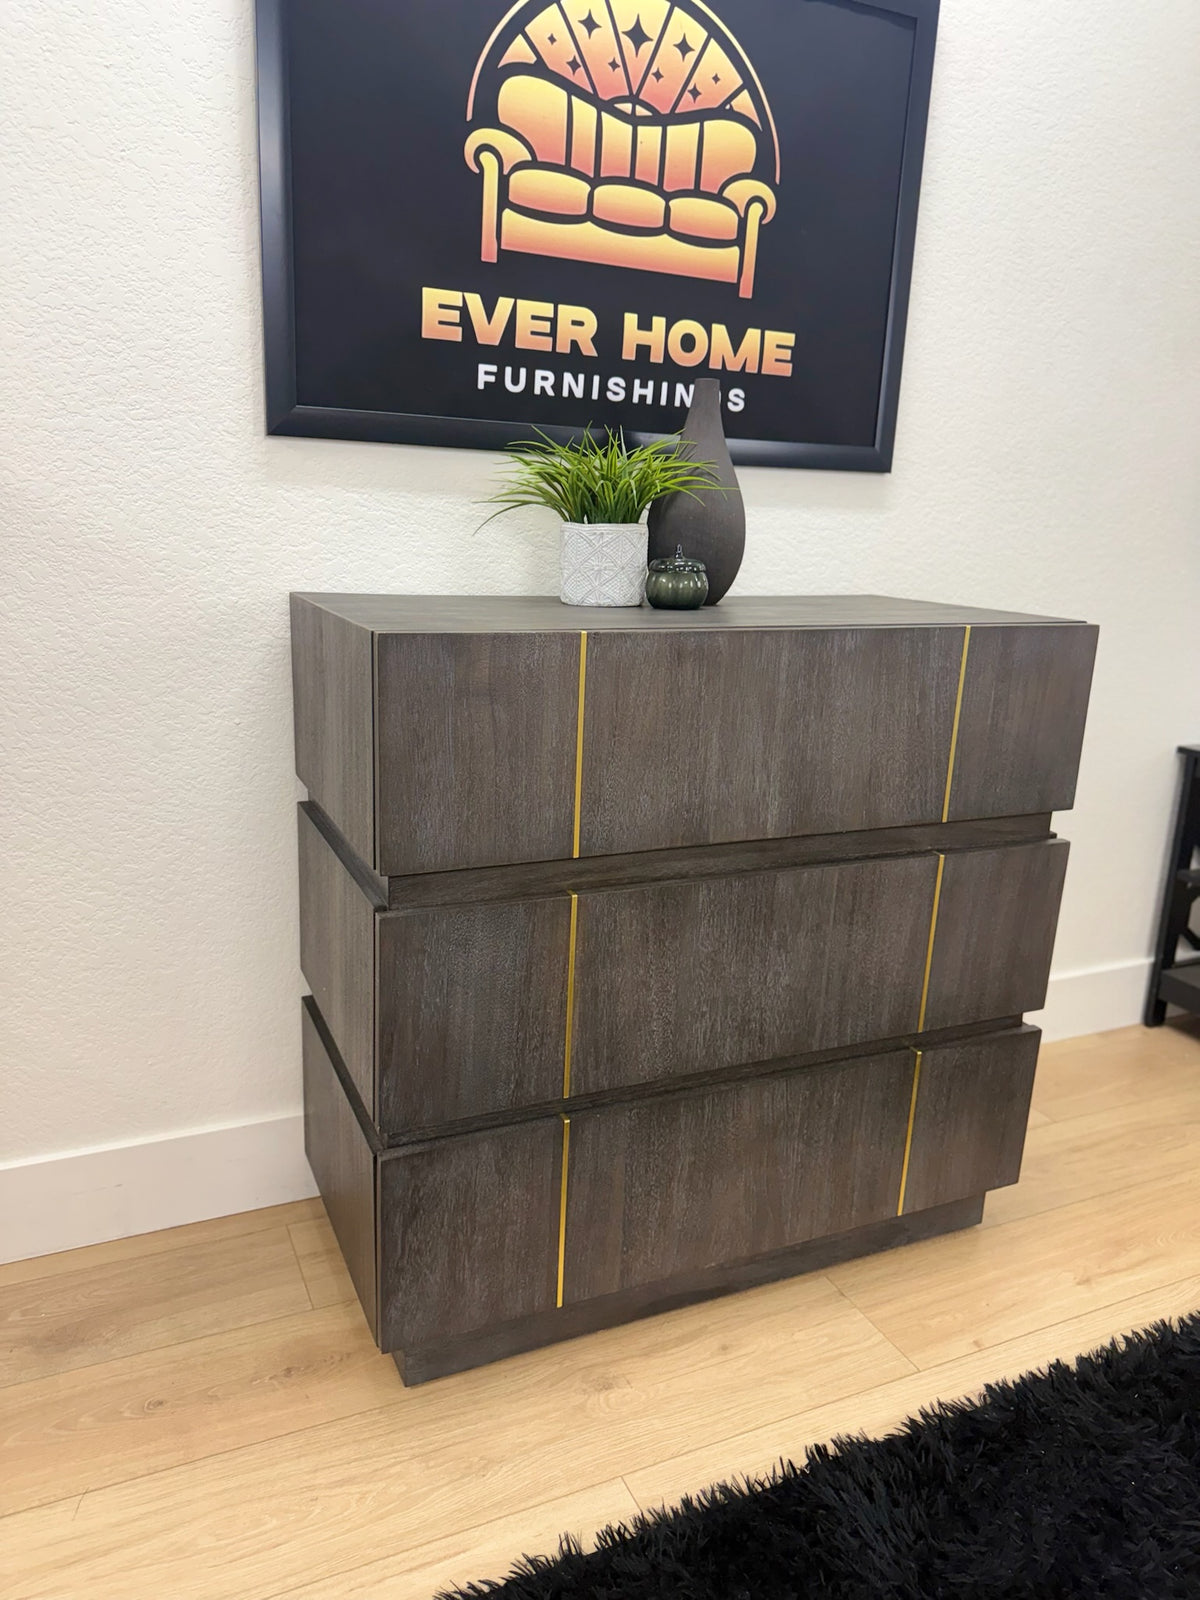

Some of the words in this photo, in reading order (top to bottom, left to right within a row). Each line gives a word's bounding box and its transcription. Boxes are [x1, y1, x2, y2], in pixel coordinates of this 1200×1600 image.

[421, 286, 599, 357] EVER
[621, 312, 796, 377] HOME
[477, 363, 746, 413] FURNISHINS
